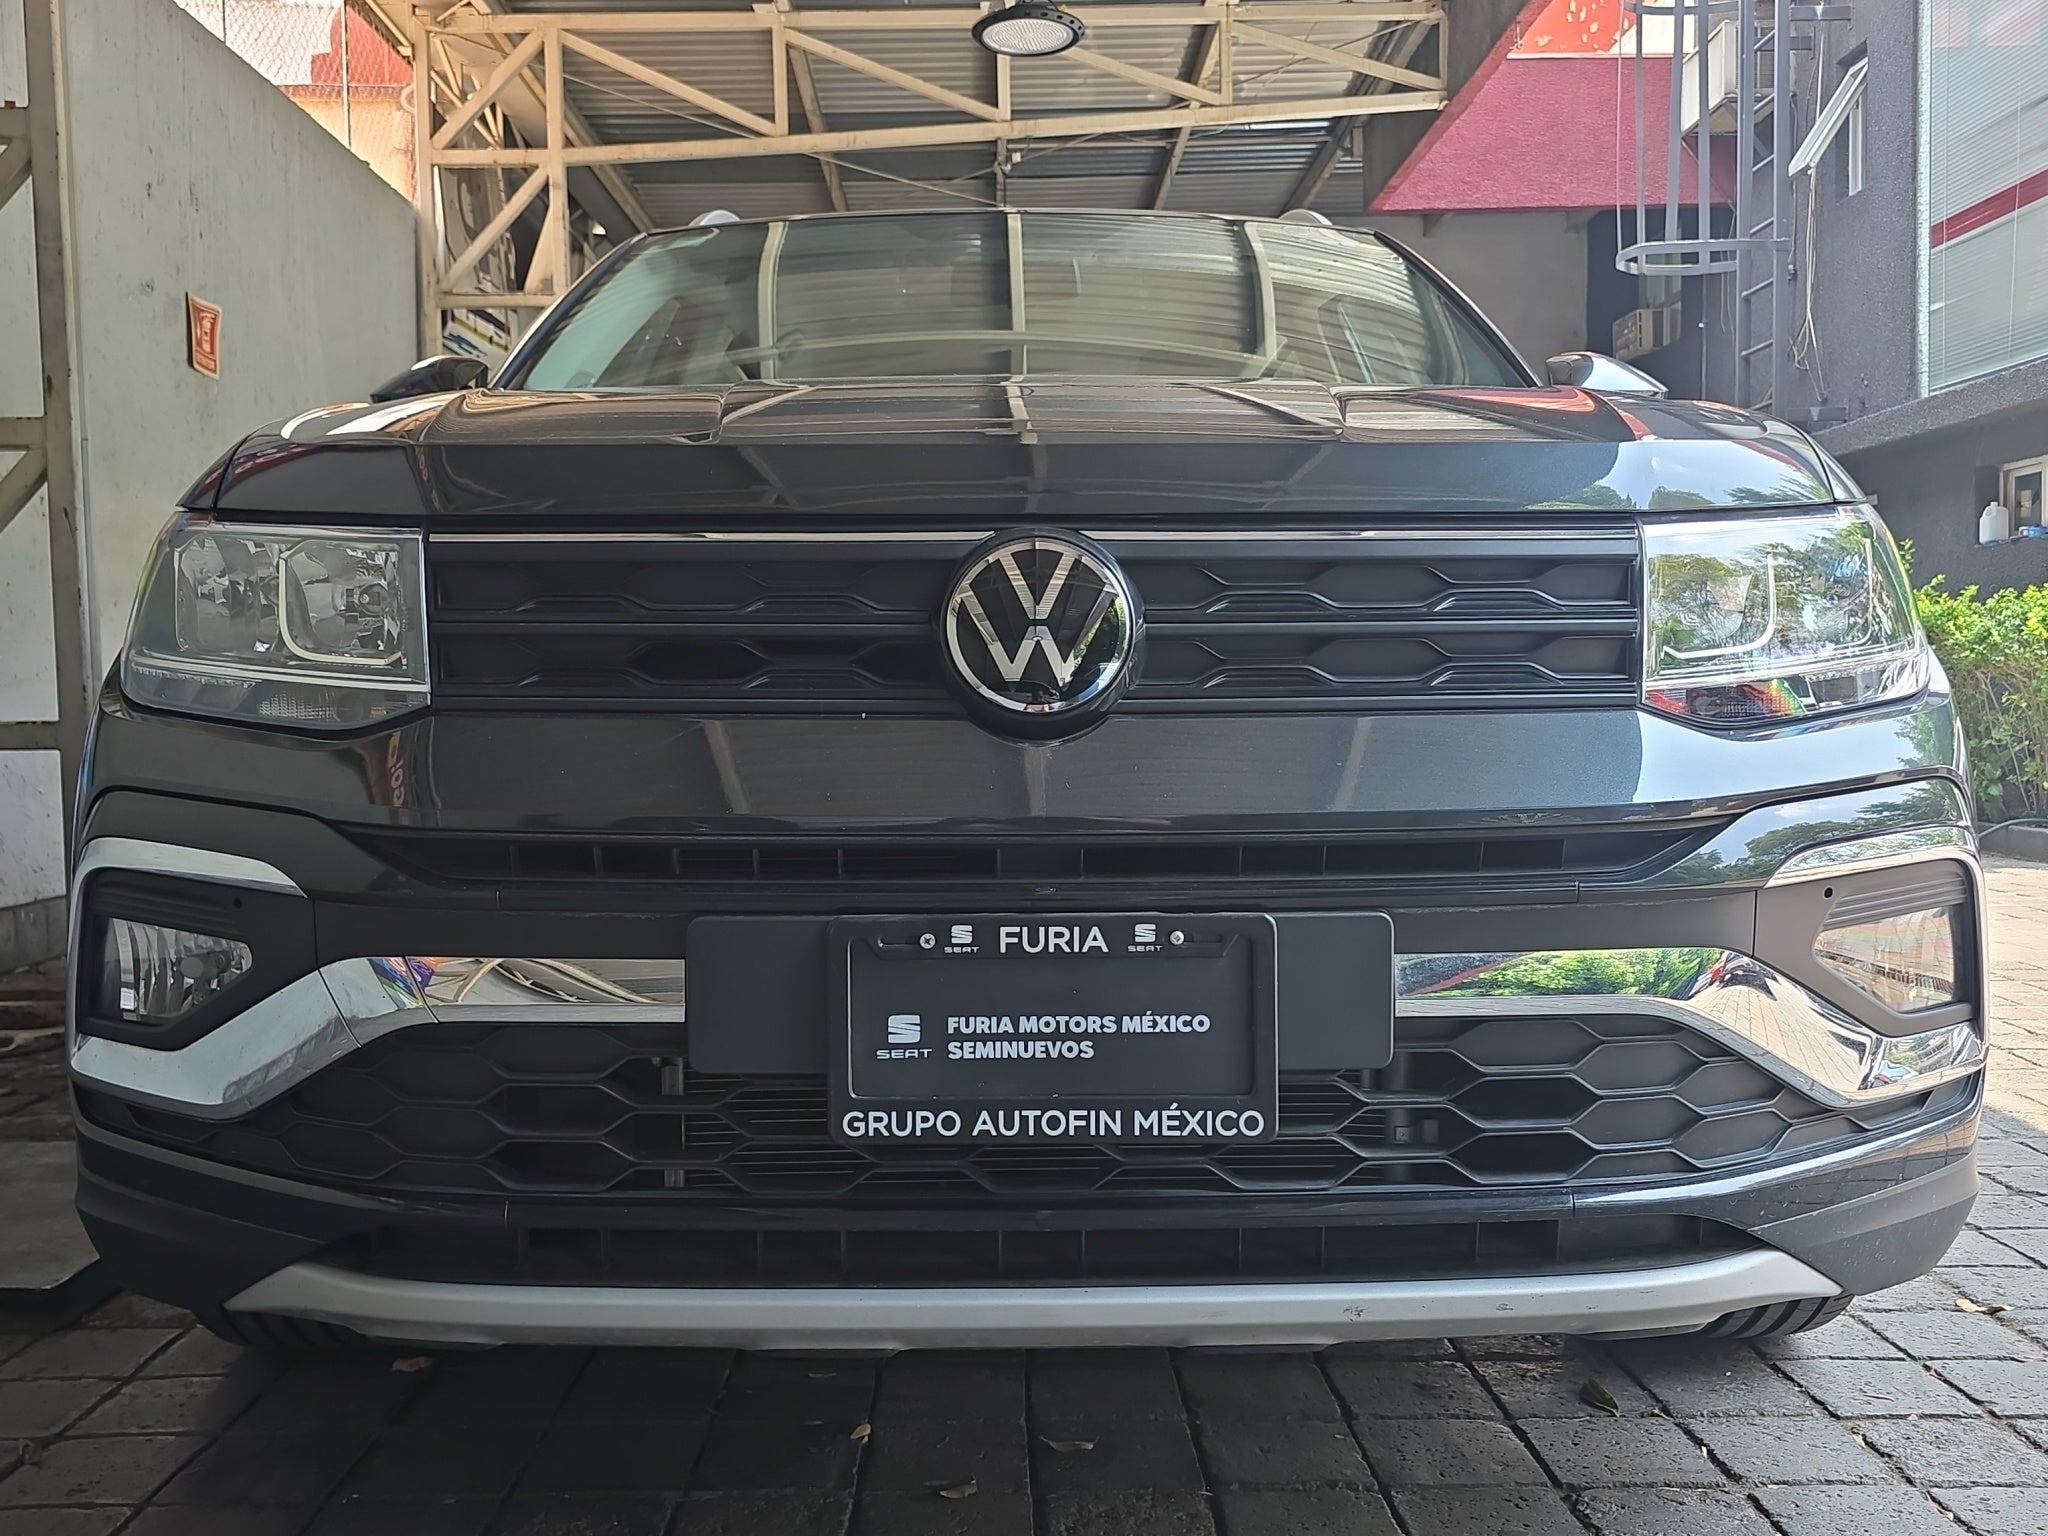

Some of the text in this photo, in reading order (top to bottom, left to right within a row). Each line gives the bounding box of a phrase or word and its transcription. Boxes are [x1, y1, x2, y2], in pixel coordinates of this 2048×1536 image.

[944, 946, 980, 954] SEAT
[1000, 926, 1109, 953] FURIA
[947, 1010, 1211, 1034] FURIA MOTORS MÉXICO
[876, 1049, 932, 1060] SEAT
[947, 1040, 1095, 1060] SEMINUEVOS
[842, 1102, 1265, 1137] GRUPO AUTOFIN MÉXICO
